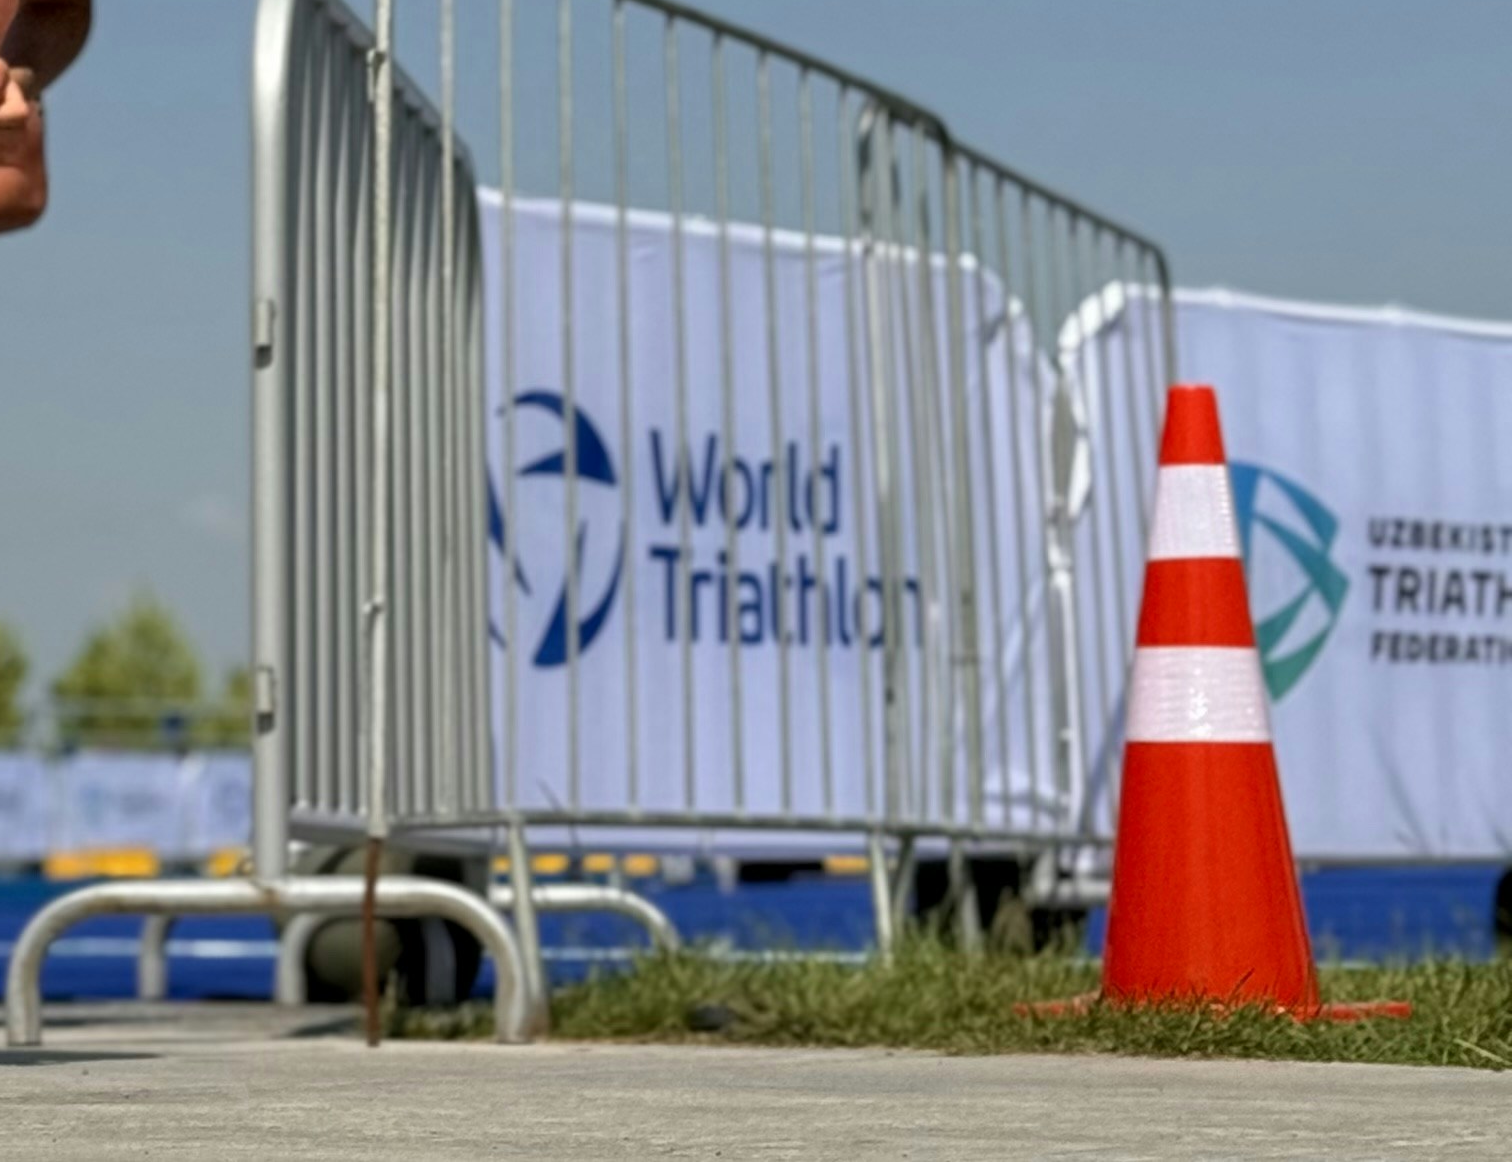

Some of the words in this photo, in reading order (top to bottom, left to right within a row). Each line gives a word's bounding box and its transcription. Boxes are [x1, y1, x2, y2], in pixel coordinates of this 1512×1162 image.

[649, 428, 840, 534] World
[648, 544, 925, 649] Triathlon
[1368, 564, 1512, 618] TRIATH
[1372, 631, 1512, 666] FEDERATI
